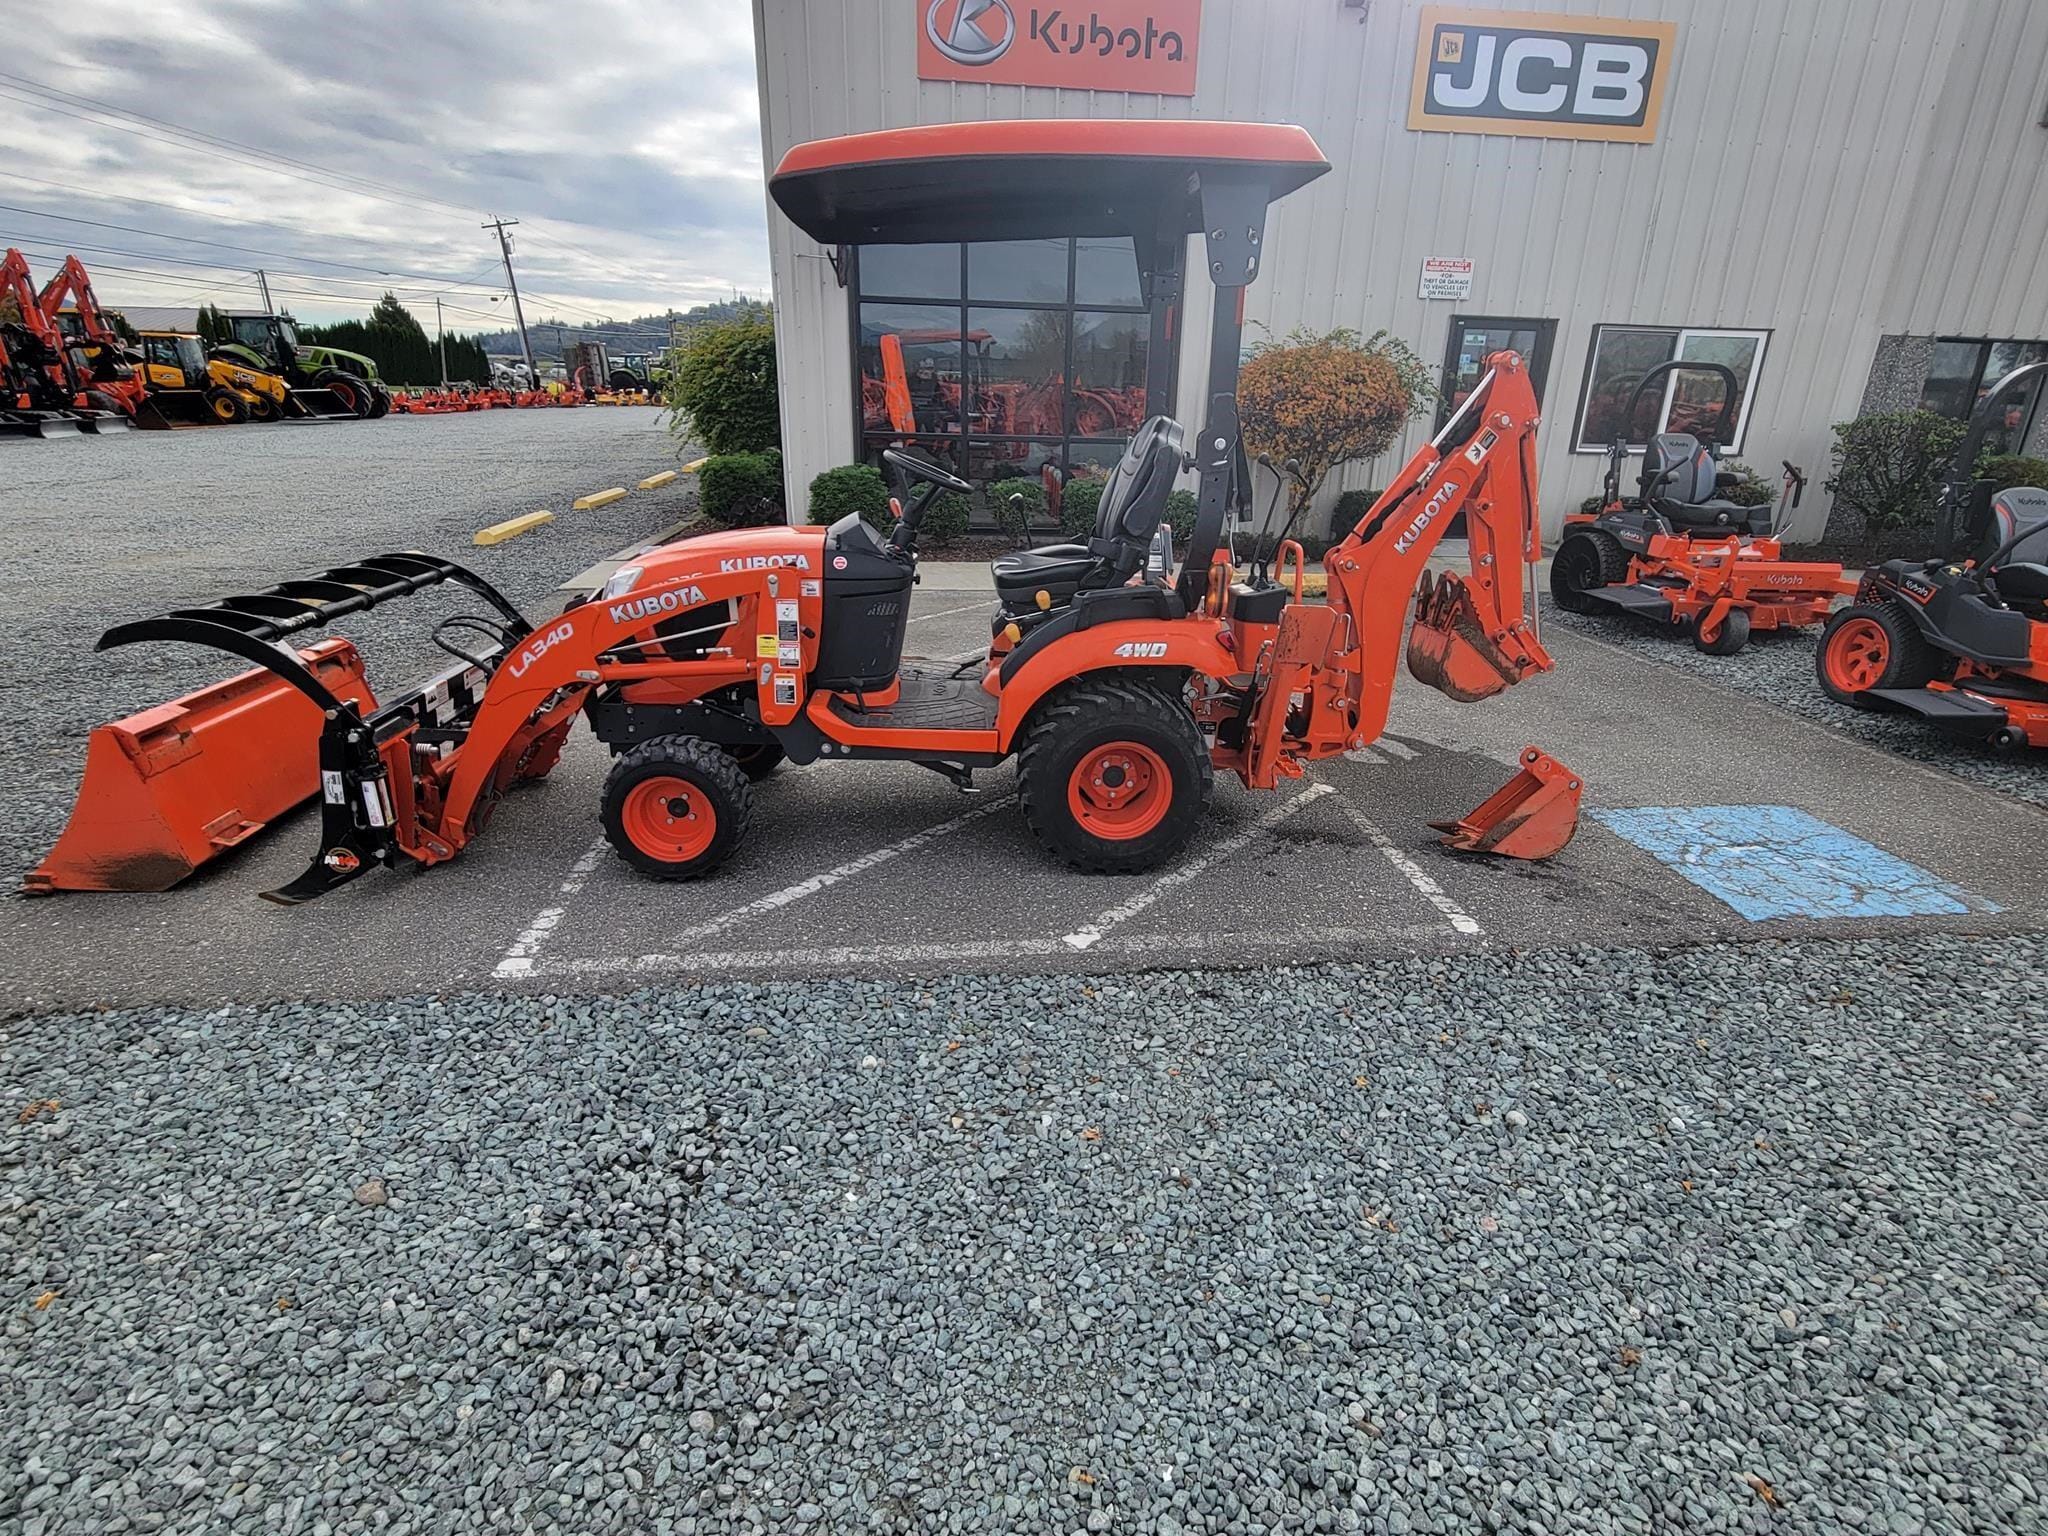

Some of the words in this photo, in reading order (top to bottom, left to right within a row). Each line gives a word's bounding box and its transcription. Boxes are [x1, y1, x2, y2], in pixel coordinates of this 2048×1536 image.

[1030, 9, 1183, 61] Kubota
[1433, 35, 1648, 117] JCB
[1393, 481, 1461, 555] KUBOTA
[720, 554, 810, 573] KUBOTA
[1767, 574, 1803, 585] Kubota
[609, 585, 708, 625] KUBOTA
[1905, 578, 1930, 597] Kubota
[509, 622, 574, 678] LA340
[1113, 643, 1168, 657] 4WD
